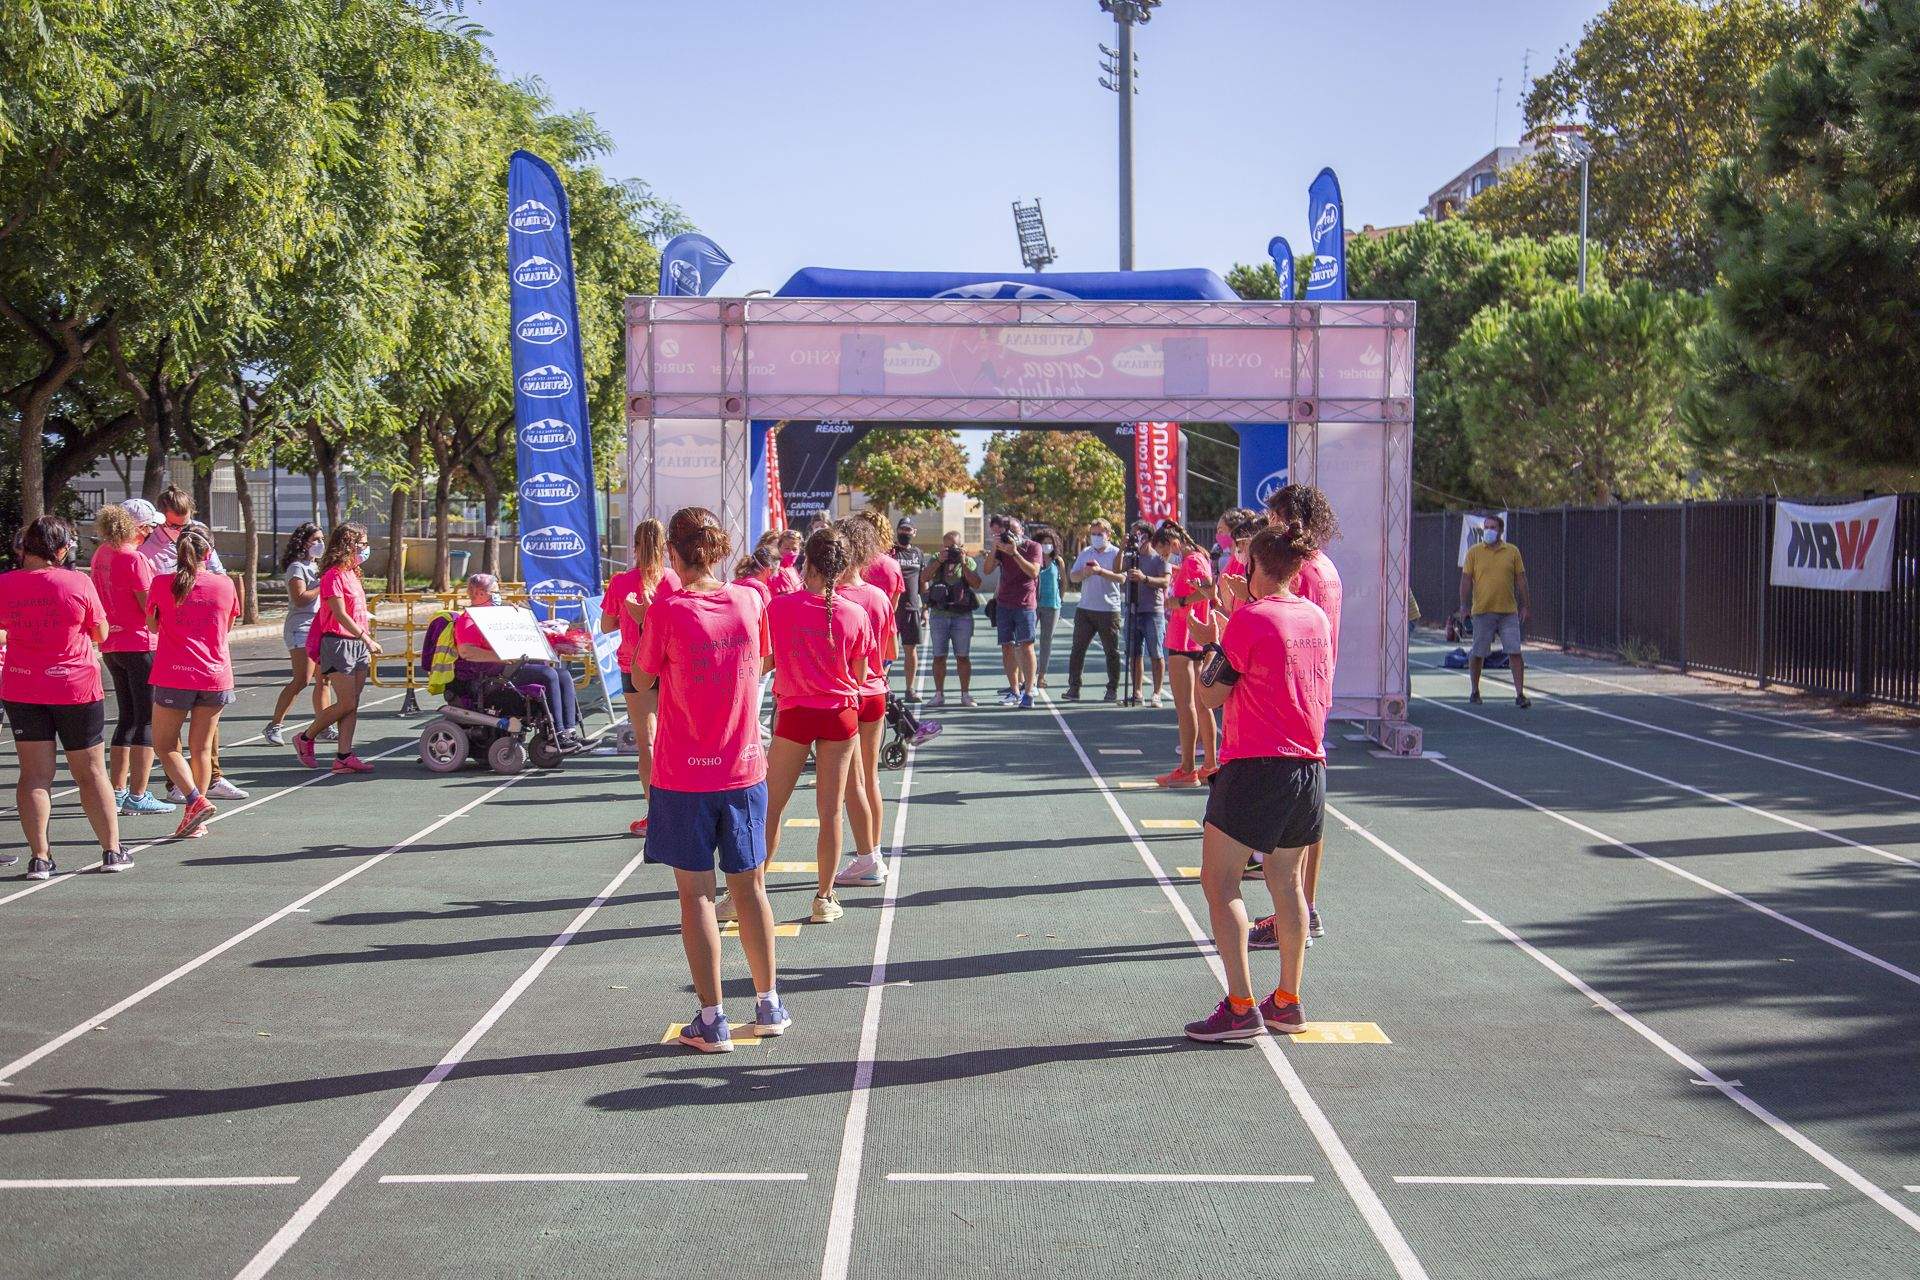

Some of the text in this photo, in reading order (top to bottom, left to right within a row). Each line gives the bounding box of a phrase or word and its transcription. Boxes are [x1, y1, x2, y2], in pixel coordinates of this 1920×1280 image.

[815, 425, 854, 434] REASON
[1788, 518, 1879, 570] MRW
[1286, 638, 1328, 649] CARRERA
[688, 756, 722, 766] OYSHO
